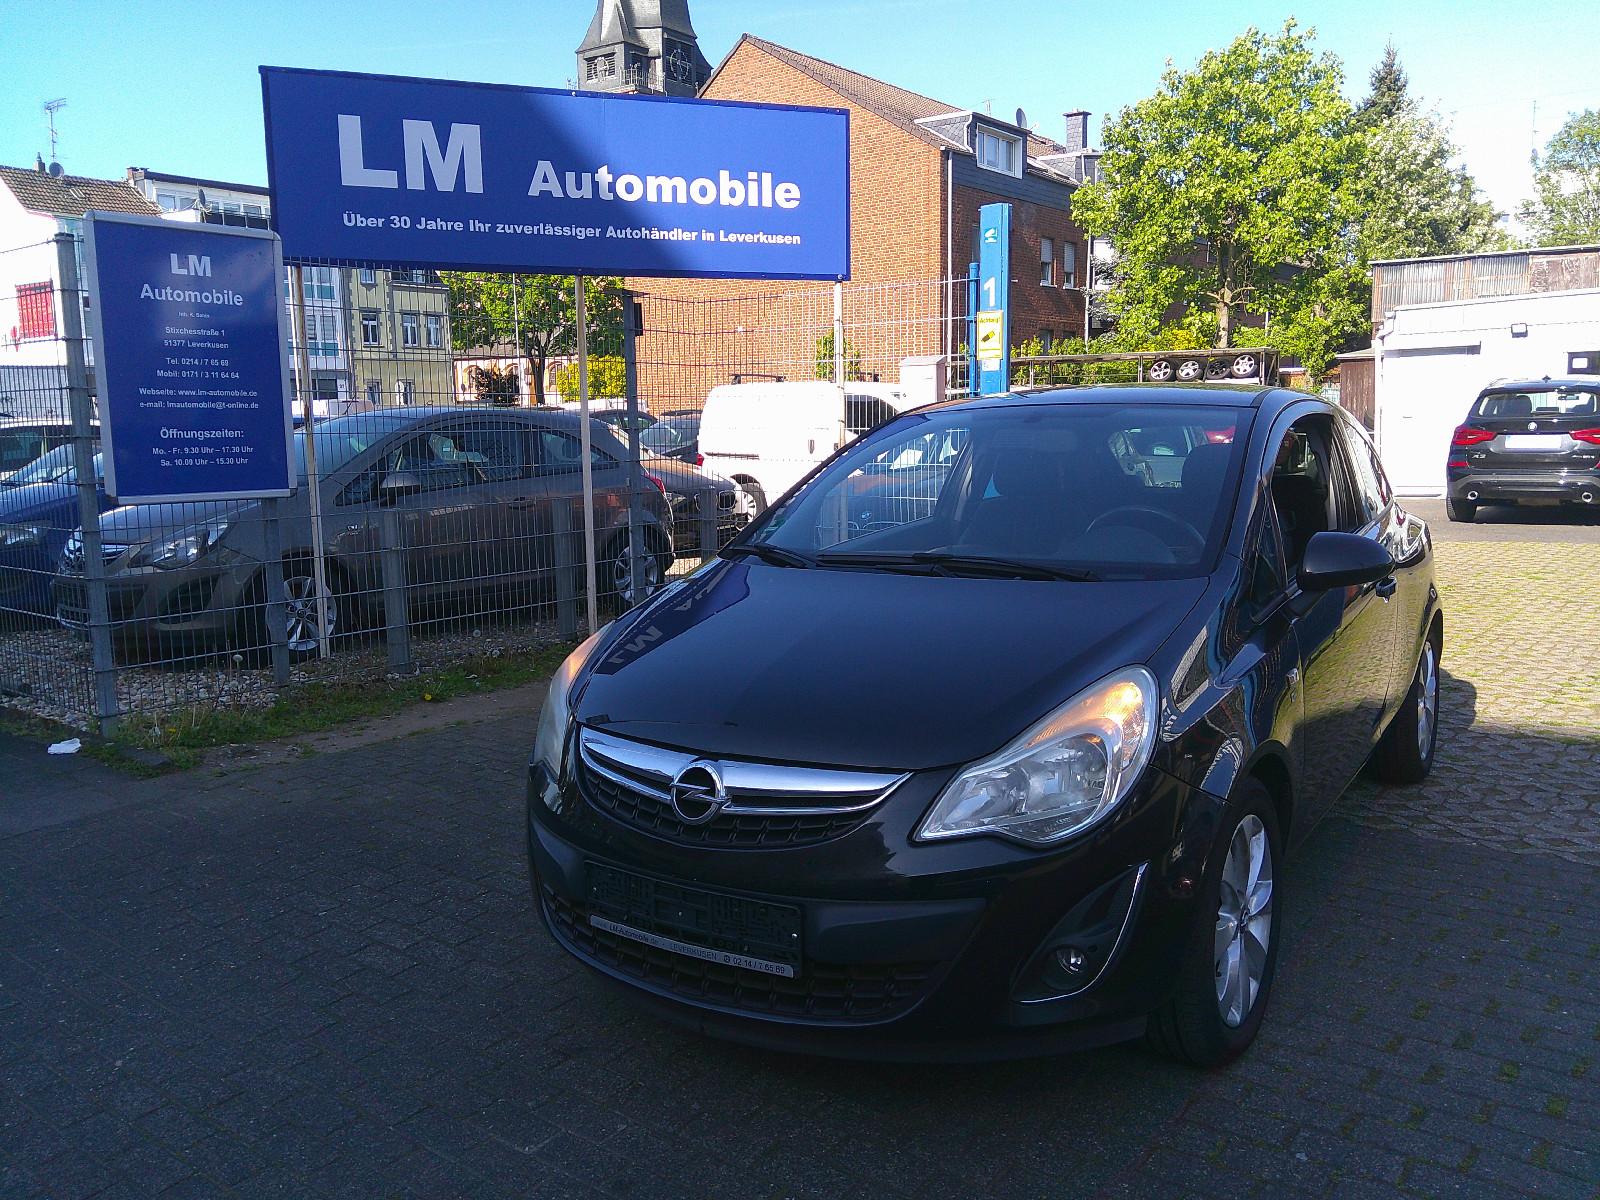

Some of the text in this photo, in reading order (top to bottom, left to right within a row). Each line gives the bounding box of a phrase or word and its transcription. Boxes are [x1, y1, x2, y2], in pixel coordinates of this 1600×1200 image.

[336, 113, 485, 195] LM
[526, 160, 802, 209] Automobile
[342, 211, 802, 246] Über 30 Jahre Ihr zuverlässiger Autohändler in Leverkusen
[169, 253, 212, 278] LM
[139, 283, 243, 307] Automobile
[984, 277, 996, 307] 1
[165, 327, 219, 337] Stixchesstraße
[188, 340, 229, 349] Leverkusen
[182, 358, 199, 366] 0214
[157, 370, 180, 378] Mobil:
[178, 389, 258, 397] www.lm-automobile.de
[167, 401, 259, 410] lmautomobile@t-online.de
[160, 427, 244, 440] Öffnungszeiten:
[236, 457, 249, 465] Uhr
[733, 957, 742, 966] 02
[742, 958, 752, 968] 14
